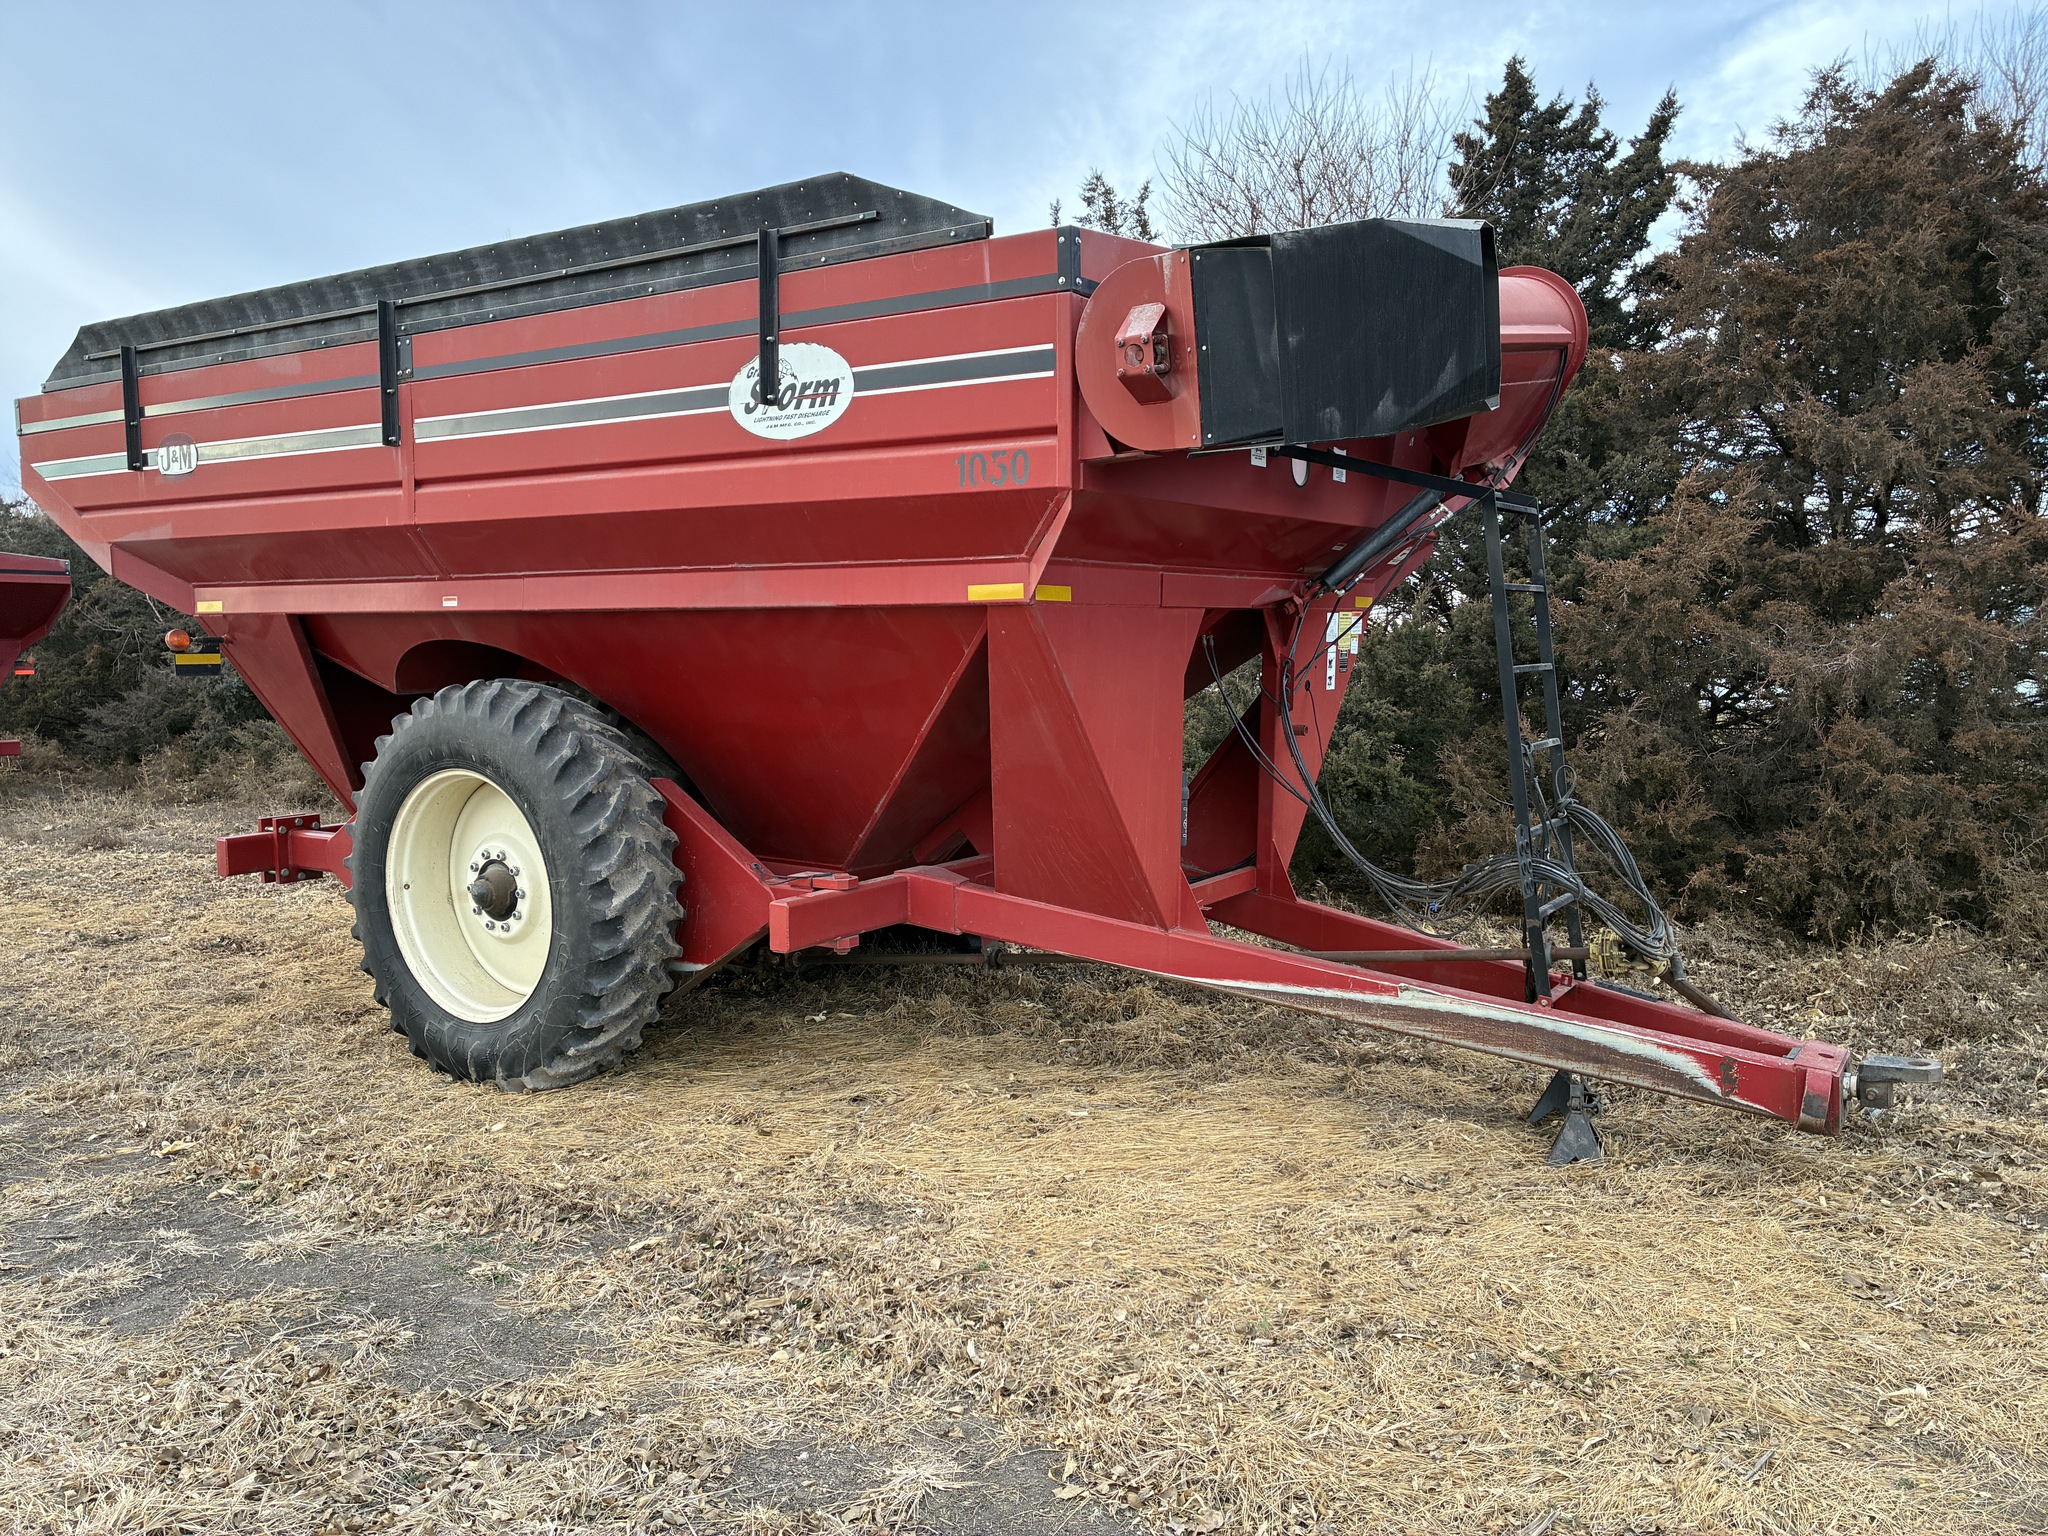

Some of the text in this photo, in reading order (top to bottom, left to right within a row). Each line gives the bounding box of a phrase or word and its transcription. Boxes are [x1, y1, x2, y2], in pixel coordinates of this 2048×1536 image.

[744, 377, 840, 415] Sorm
[753, 409, 831, 423] LIGHTNING FAST DISCHARGE
[160, 444, 193, 472] J&M
[954, 449, 1030, 489] 1050
